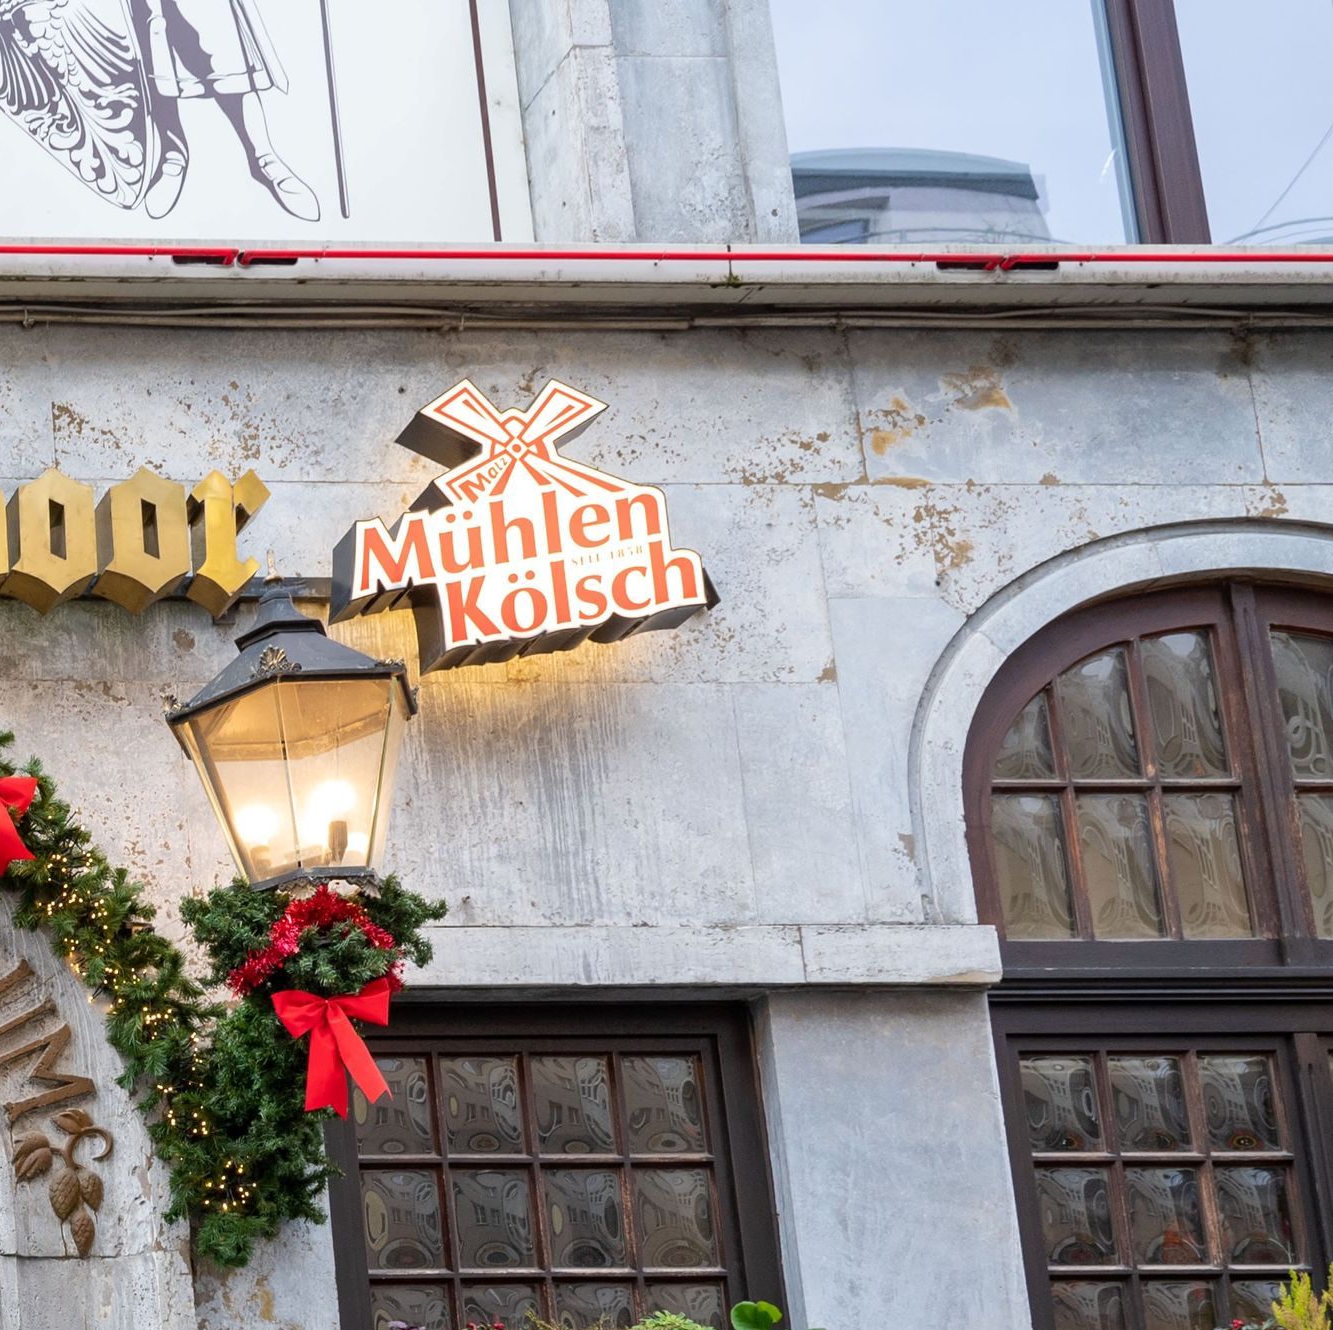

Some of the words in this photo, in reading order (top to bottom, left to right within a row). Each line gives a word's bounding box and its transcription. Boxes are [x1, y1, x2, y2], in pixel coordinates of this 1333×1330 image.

[459, 455, 508, 503] Malz
[359, 490, 662, 592] Mühlen
[445, 540, 698, 643] Kölsch
